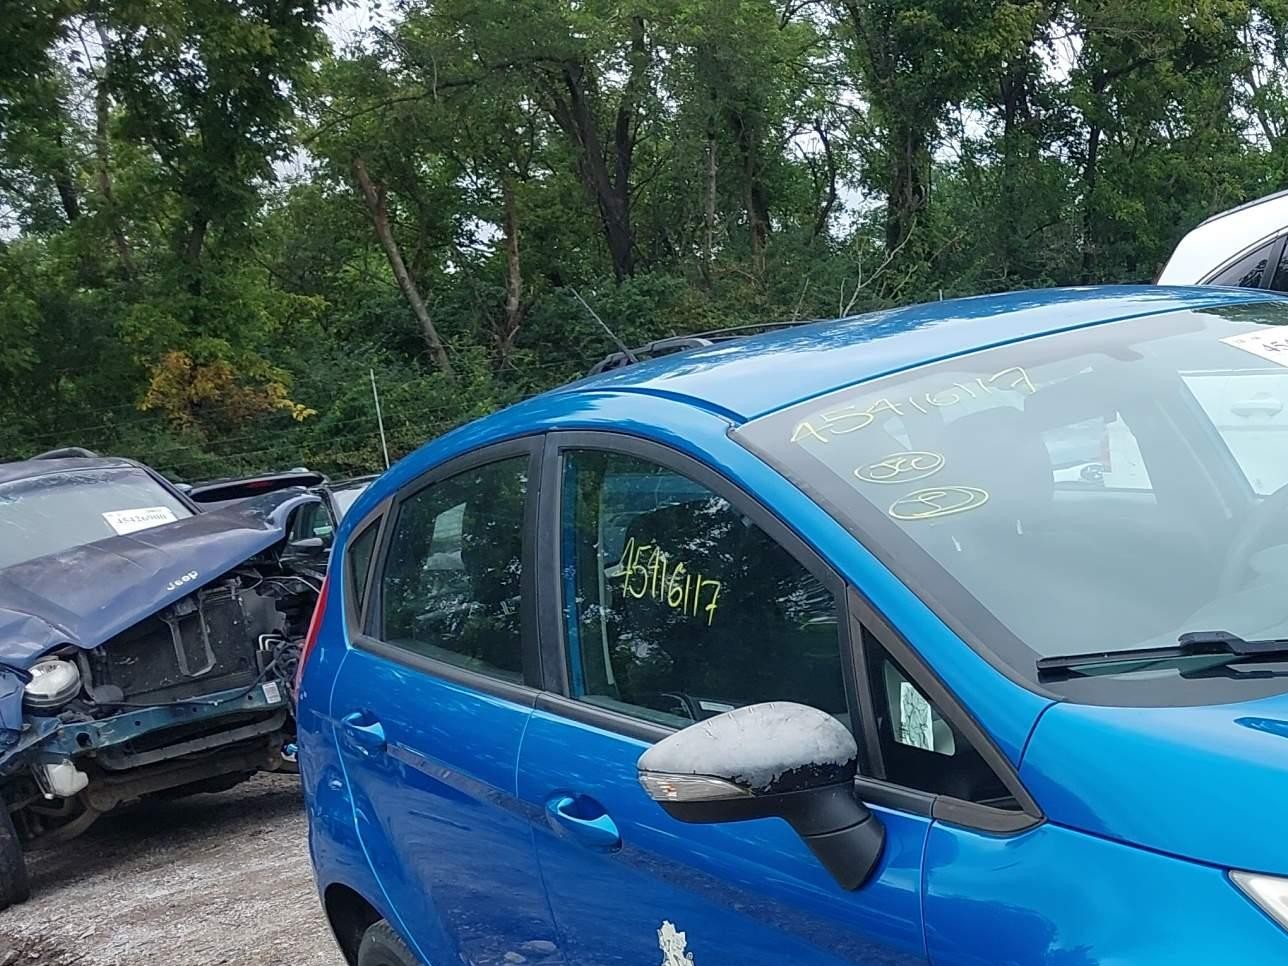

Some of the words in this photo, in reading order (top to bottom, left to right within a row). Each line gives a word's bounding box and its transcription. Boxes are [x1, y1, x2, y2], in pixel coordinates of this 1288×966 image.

[790, 366, 1037, 443] 45416117
[167, 570, 199, 591] Jeep
[612, 537, 722, 627] 45416117
